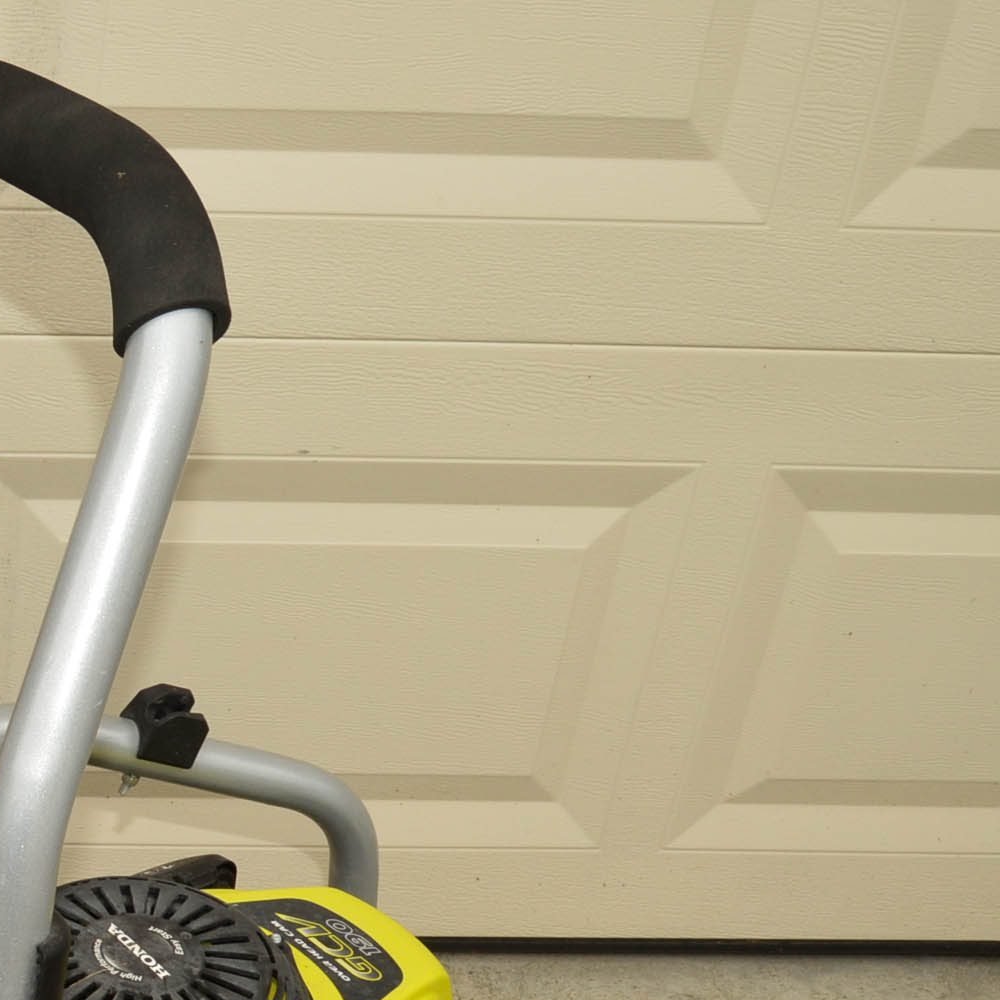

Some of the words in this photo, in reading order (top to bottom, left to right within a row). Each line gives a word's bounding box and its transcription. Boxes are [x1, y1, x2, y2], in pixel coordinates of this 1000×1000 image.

[147, 925, 174, 940] Start
[270, 920, 295, 937] CAM
[325, 918, 382, 956] 190
[108, 922, 171, 980] HONDA
[275, 912, 384, 982] GCV
[293, 938, 324, 960] HEAD
[120, 972, 143, 982] High
[322, 960, 352, 982] OVER
